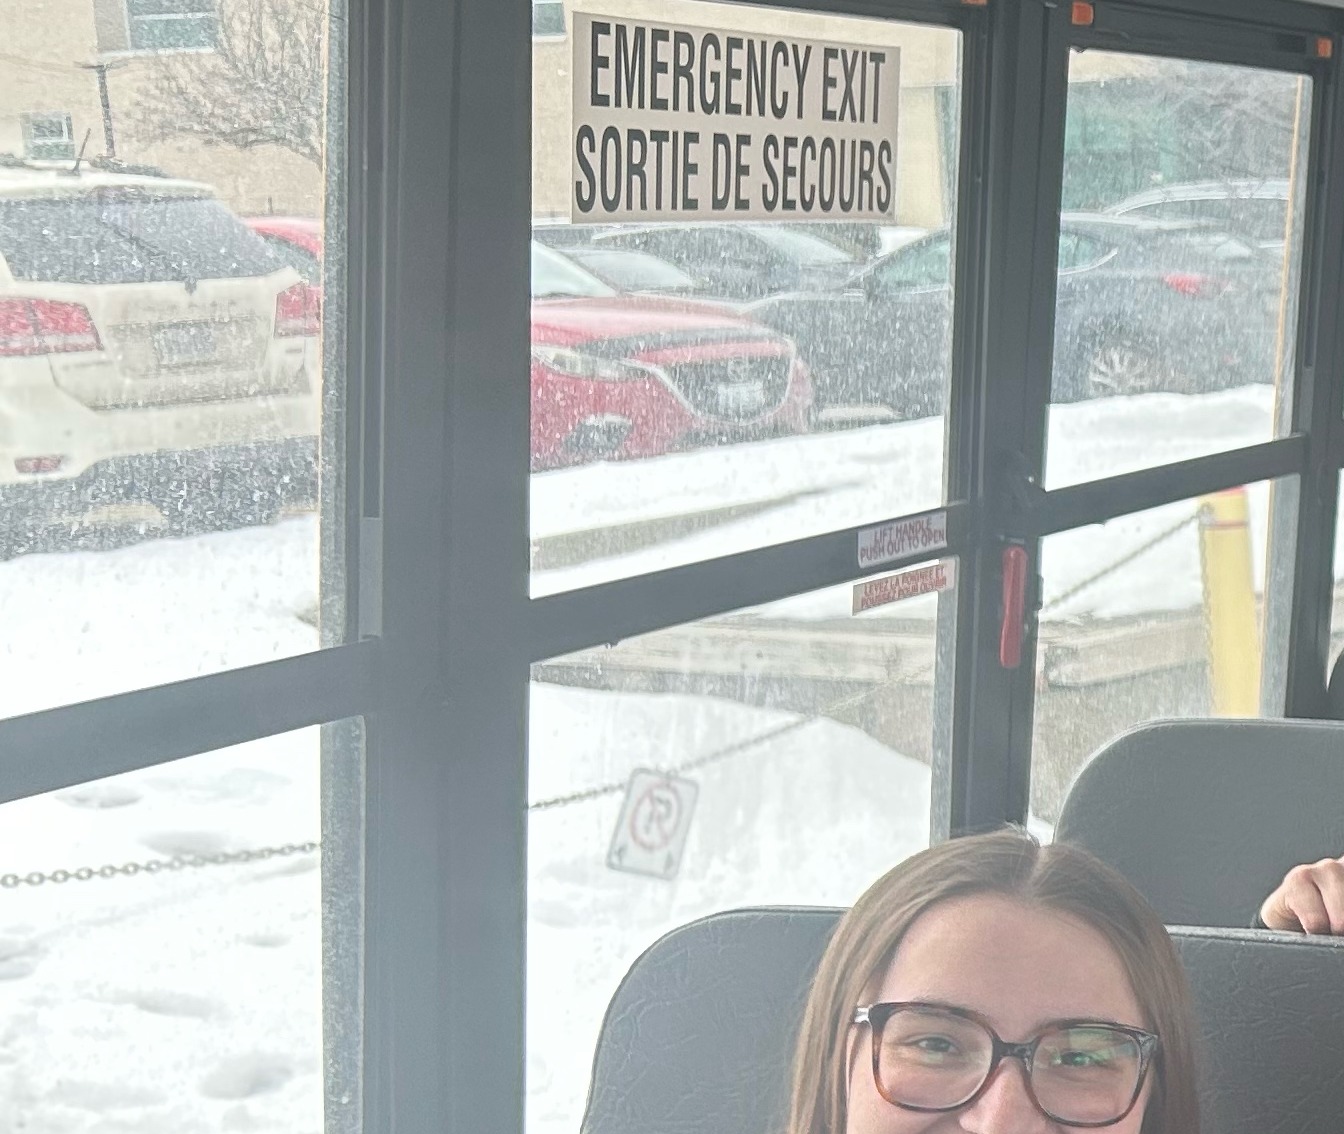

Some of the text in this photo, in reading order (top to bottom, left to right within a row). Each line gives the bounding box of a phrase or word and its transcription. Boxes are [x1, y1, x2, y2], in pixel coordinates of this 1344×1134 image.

[591, 21, 886, 123] EMERGENCY EXIT
[575, 124, 893, 214] SORTIE DE SECOURS
[860, 528, 945, 563] PUSH OUT TO OPEN
[874, 518, 933, 544] LIFT HANDLE
